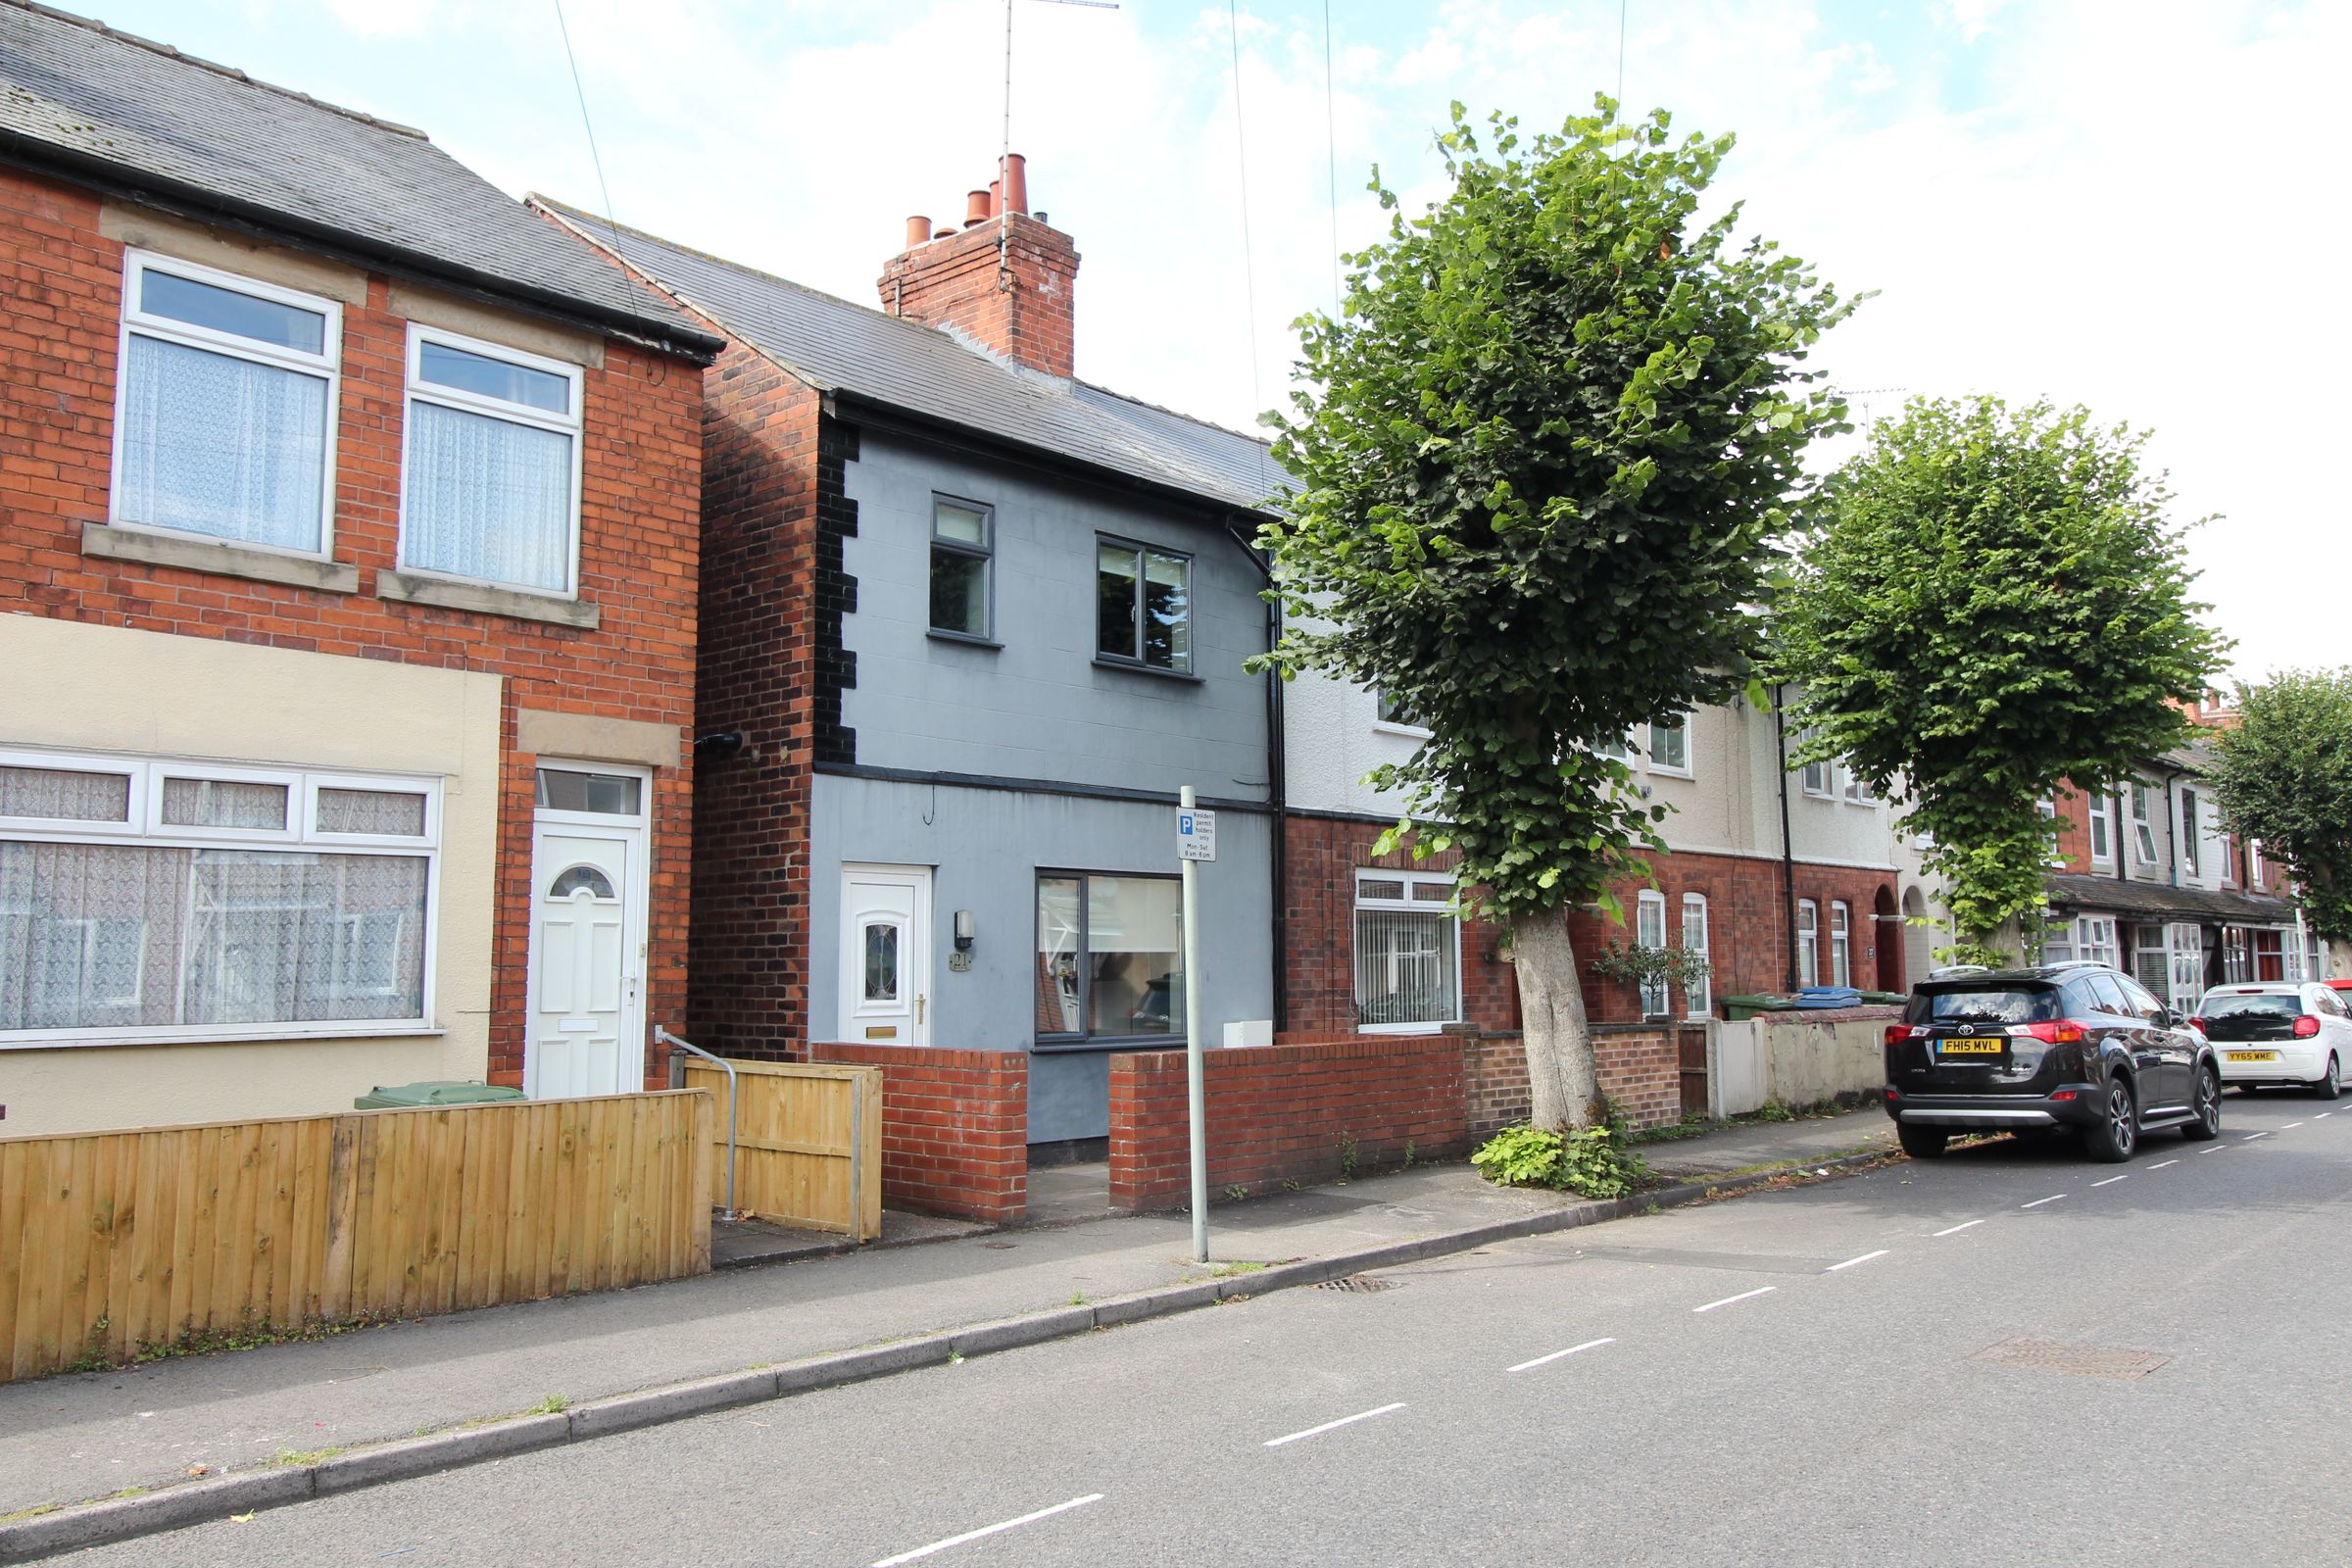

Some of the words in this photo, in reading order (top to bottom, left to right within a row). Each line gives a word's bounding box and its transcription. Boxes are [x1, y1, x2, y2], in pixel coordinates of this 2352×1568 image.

[1183, 818, 1192, 833] P
[955, 954, 966, 966] 21
[1946, 1041, 1970, 1051] FH15
[1974, 1041, 1995, 1051] MVL
